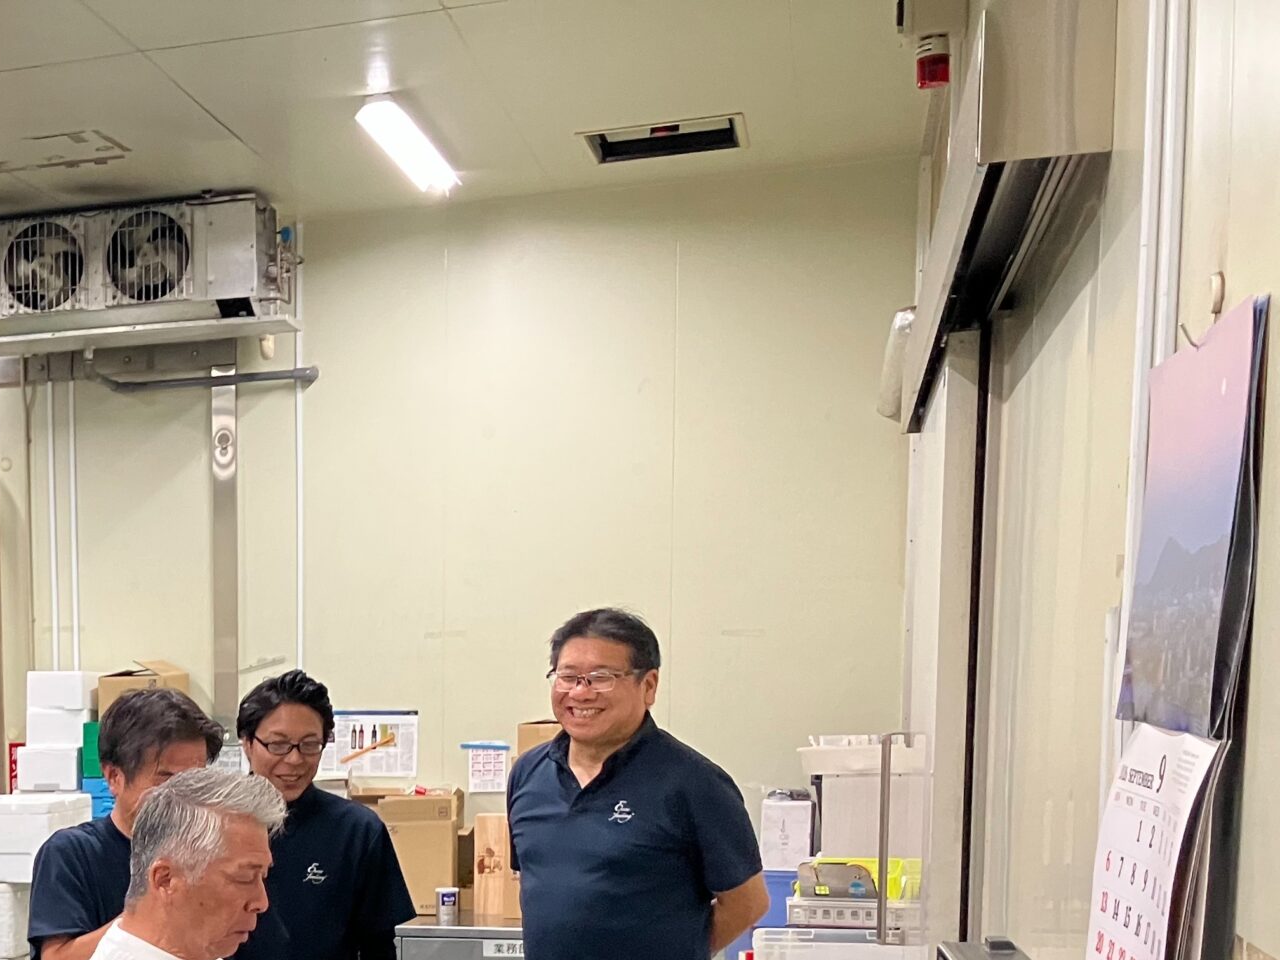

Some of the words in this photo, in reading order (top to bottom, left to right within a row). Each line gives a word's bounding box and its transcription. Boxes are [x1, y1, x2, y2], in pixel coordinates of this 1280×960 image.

[1156, 754, 1167, 793] 9
[1136, 820, 1143, 842] 1
[1149, 825, 1156, 848] 2
[1105, 850, 1112, 872] 6
[1118, 856, 1125, 878] 7
[1130, 862, 1137, 885] 8
[1142, 869, 1149, 892] 9
